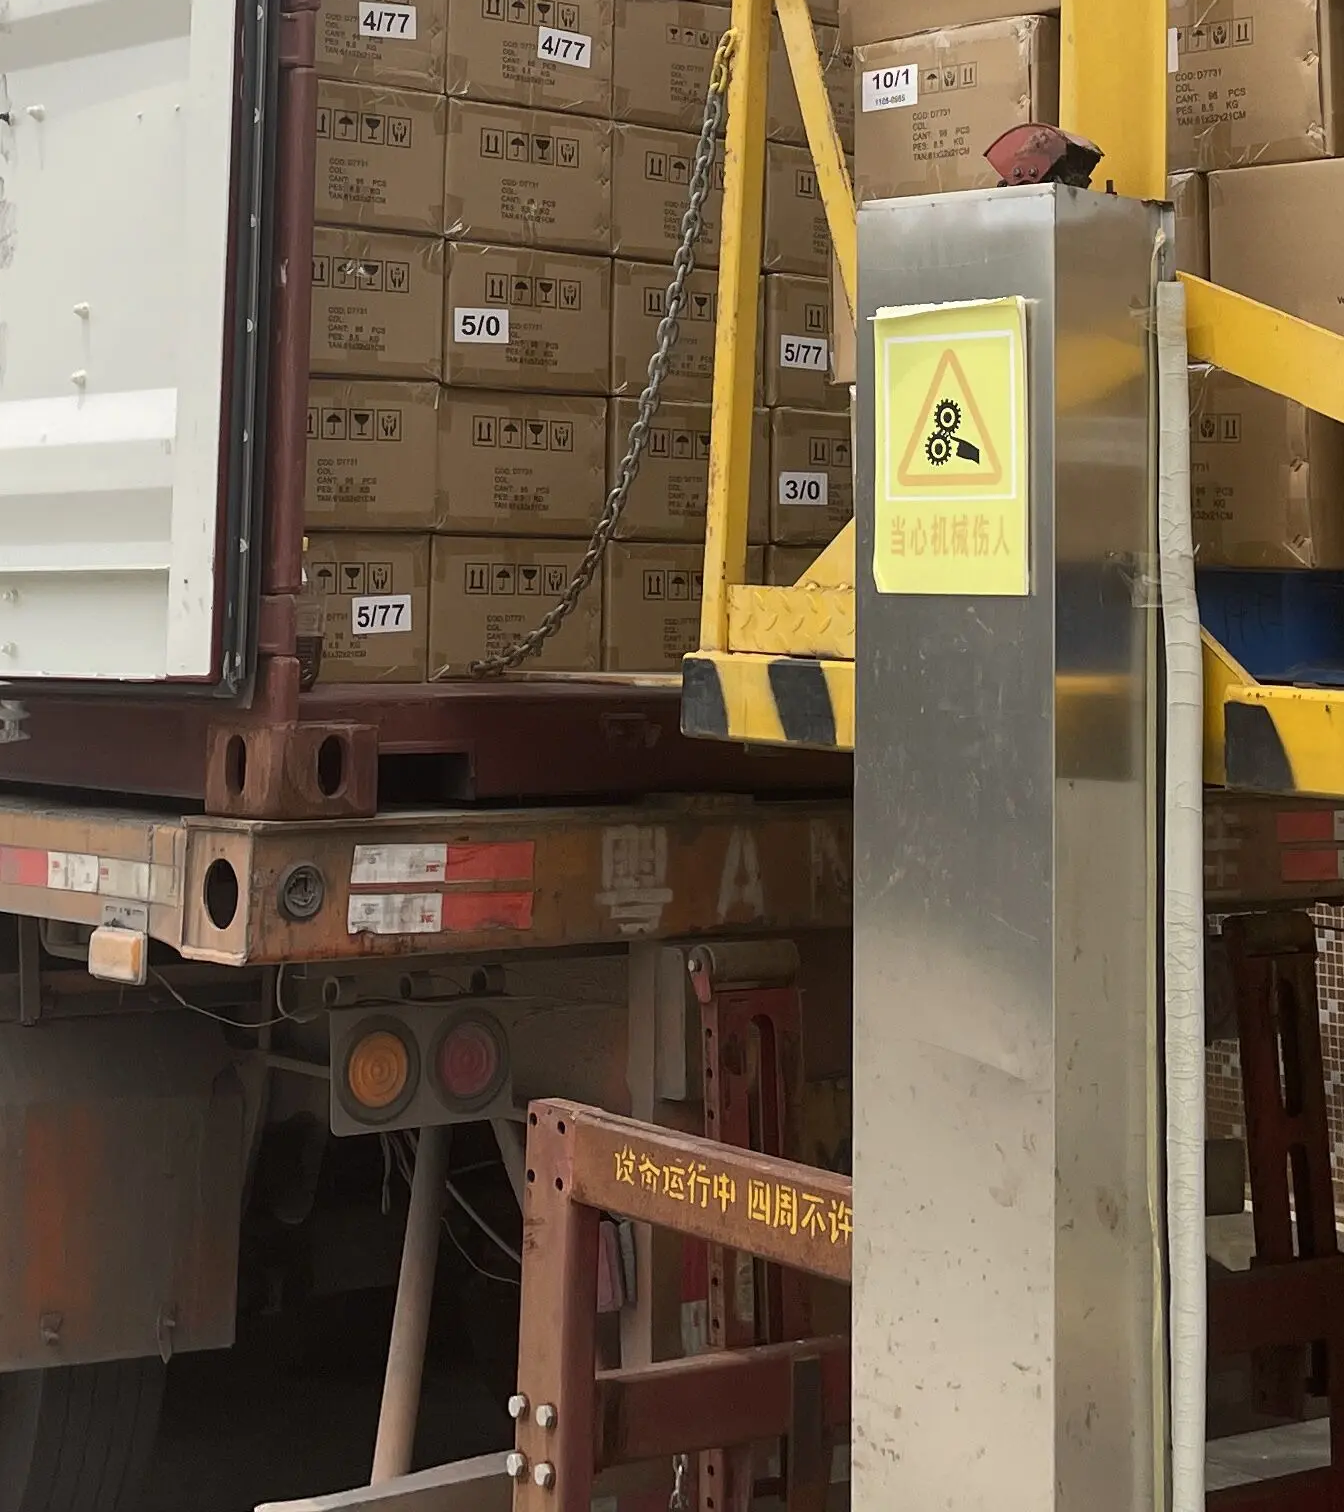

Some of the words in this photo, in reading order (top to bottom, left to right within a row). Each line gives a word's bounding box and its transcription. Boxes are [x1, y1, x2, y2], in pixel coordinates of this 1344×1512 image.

[363, 10, 411, 33] 4/77
[540, 35, 586, 61] 4/77
[872, 68, 910, 90] 10/1
[461, 314, 501, 337] 5/0
[785, 342, 823, 365] 5/77
[784, 480, 820, 500] 3/0
[890, 514, 1011, 559] 当心机械伤人
[357, 603, 406, 628] 5/77
